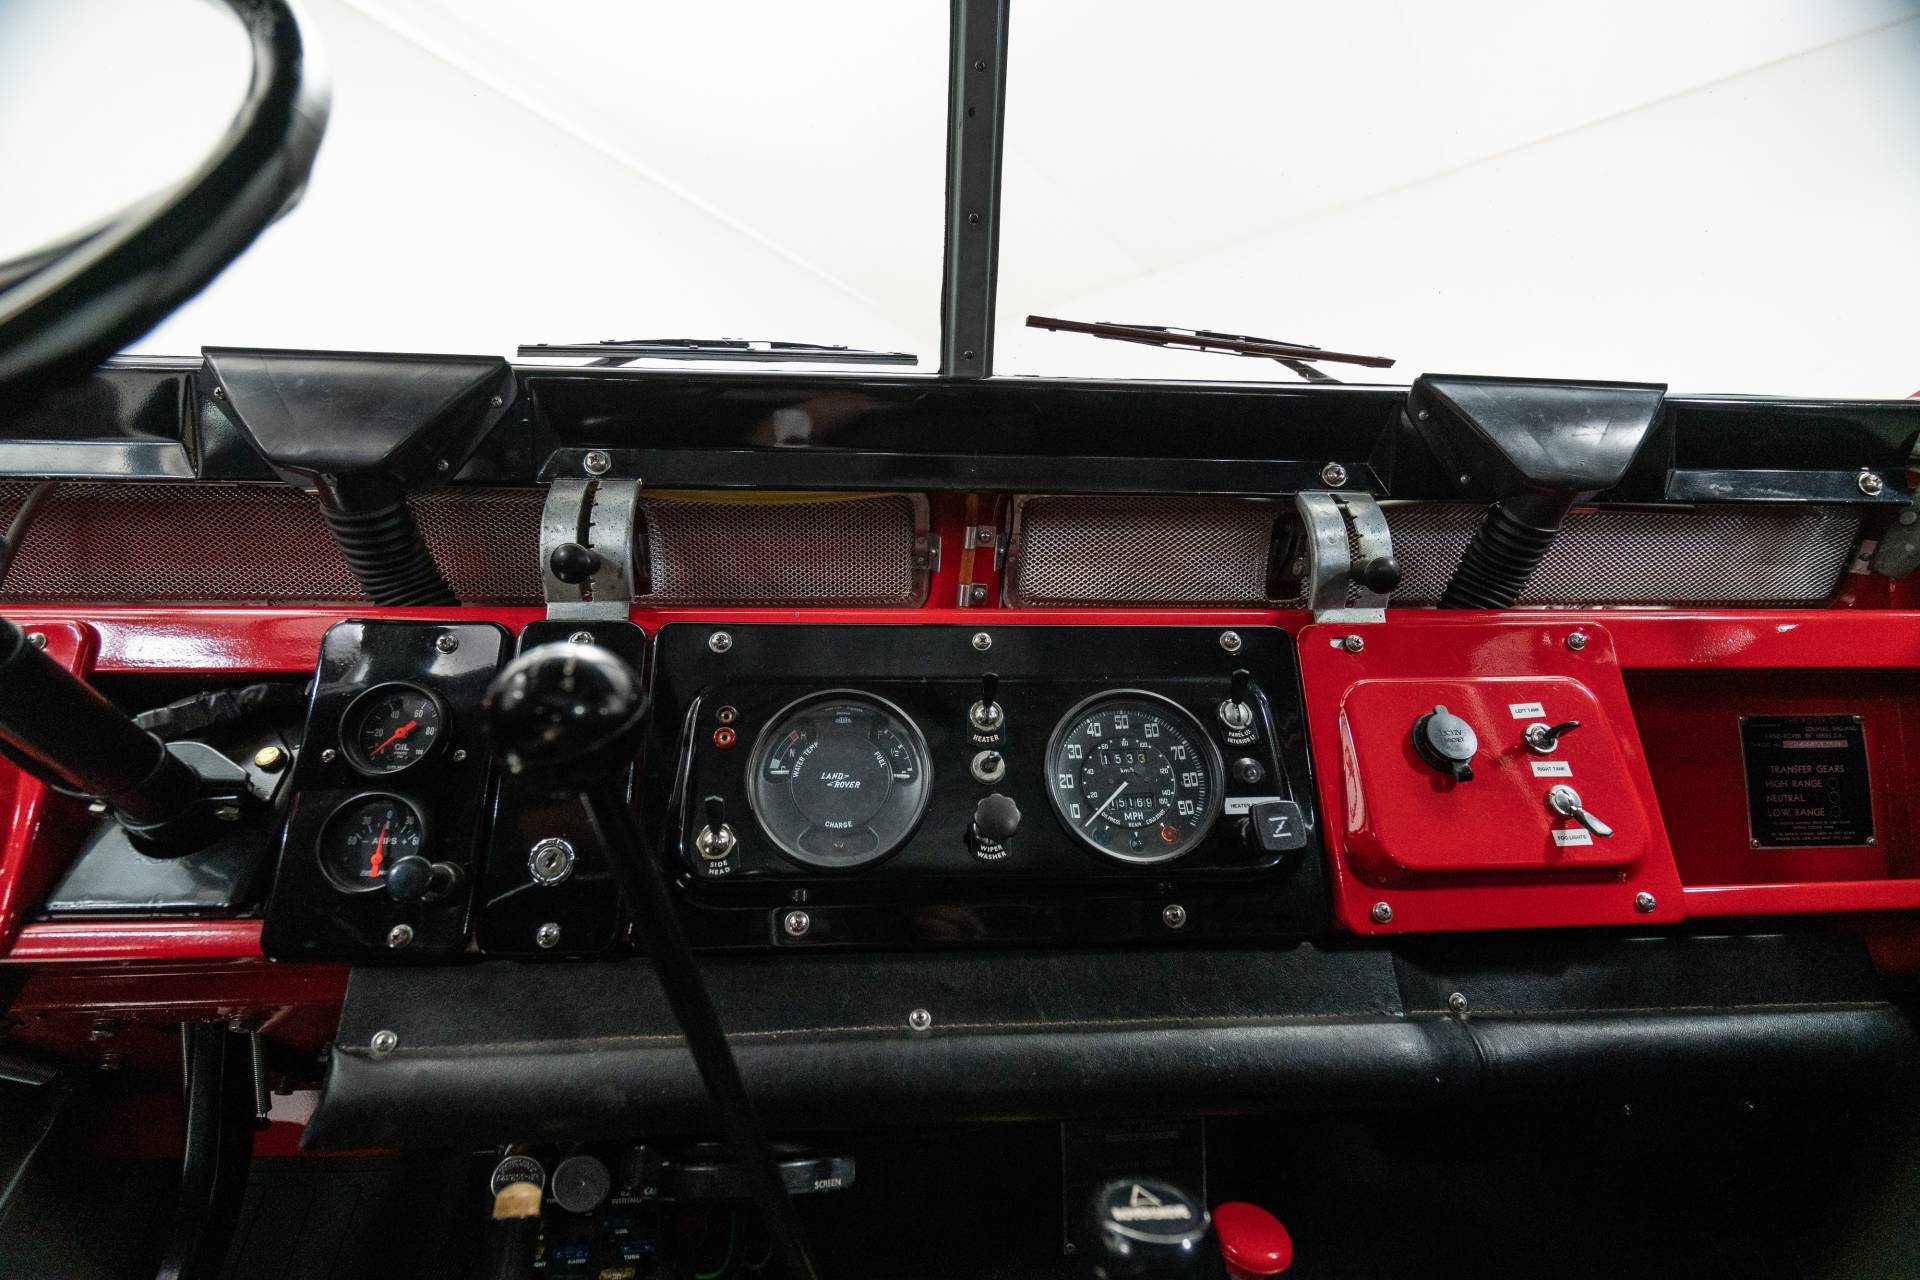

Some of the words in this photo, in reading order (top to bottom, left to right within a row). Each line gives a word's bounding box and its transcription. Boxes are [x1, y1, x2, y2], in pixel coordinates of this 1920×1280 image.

[414, 710, 423, 718] 60
[1114, 715, 1129, 730] 50
[374, 728, 384, 737] 20
[425, 726, 434, 735] 80
[1087, 722, 1101, 737] 40
[1144, 723, 1160, 738] 60
[972, 734, 1000, 743] HEATER
[1227, 737, 1250, 745] INTERIOR
[394, 743, 409, 751] OIL
[1067, 744, 1082, 759] 30
[1171, 745, 1186, 761] 70
[792, 756, 805, 778] WATER
[803, 741, 819, 756] TEMP
[873, 751, 887, 768] FUEL
[1771, 765, 1814, 774] TRANSFER
[1815, 764, 1845, 775] GEARS
[821, 772, 844, 780] LAND
[1182, 772, 1198, 787] 80
[1059, 774, 1074, 789] 20
[1766, 780, 1788, 788] HIGH
[1791, 779, 1824, 788] RANGE
[1766, 793, 1807, 803] NEUTRAL
[1069, 803, 1081, 819] 10
[1177, 799, 1194, 816] 90
[1768, 808, 1790, 817] LOW
[1795, 807, 1825, 817] RANGE
[1107, 815, 1121, 825] PRESS
[1124, 811, 1144, 820] MPH
[824, 820, 853, 829] CHARGE
[1145, 817, 1156, 825] COLD
[980, 844, 1003, 852] WIPER
[977, 850, 1007, 860] WASHER
[709, 859, 728, 868] SIDE
[708, 866, 730, 875] HEAD
[814, 1177, 841, 1190] SCREEN
